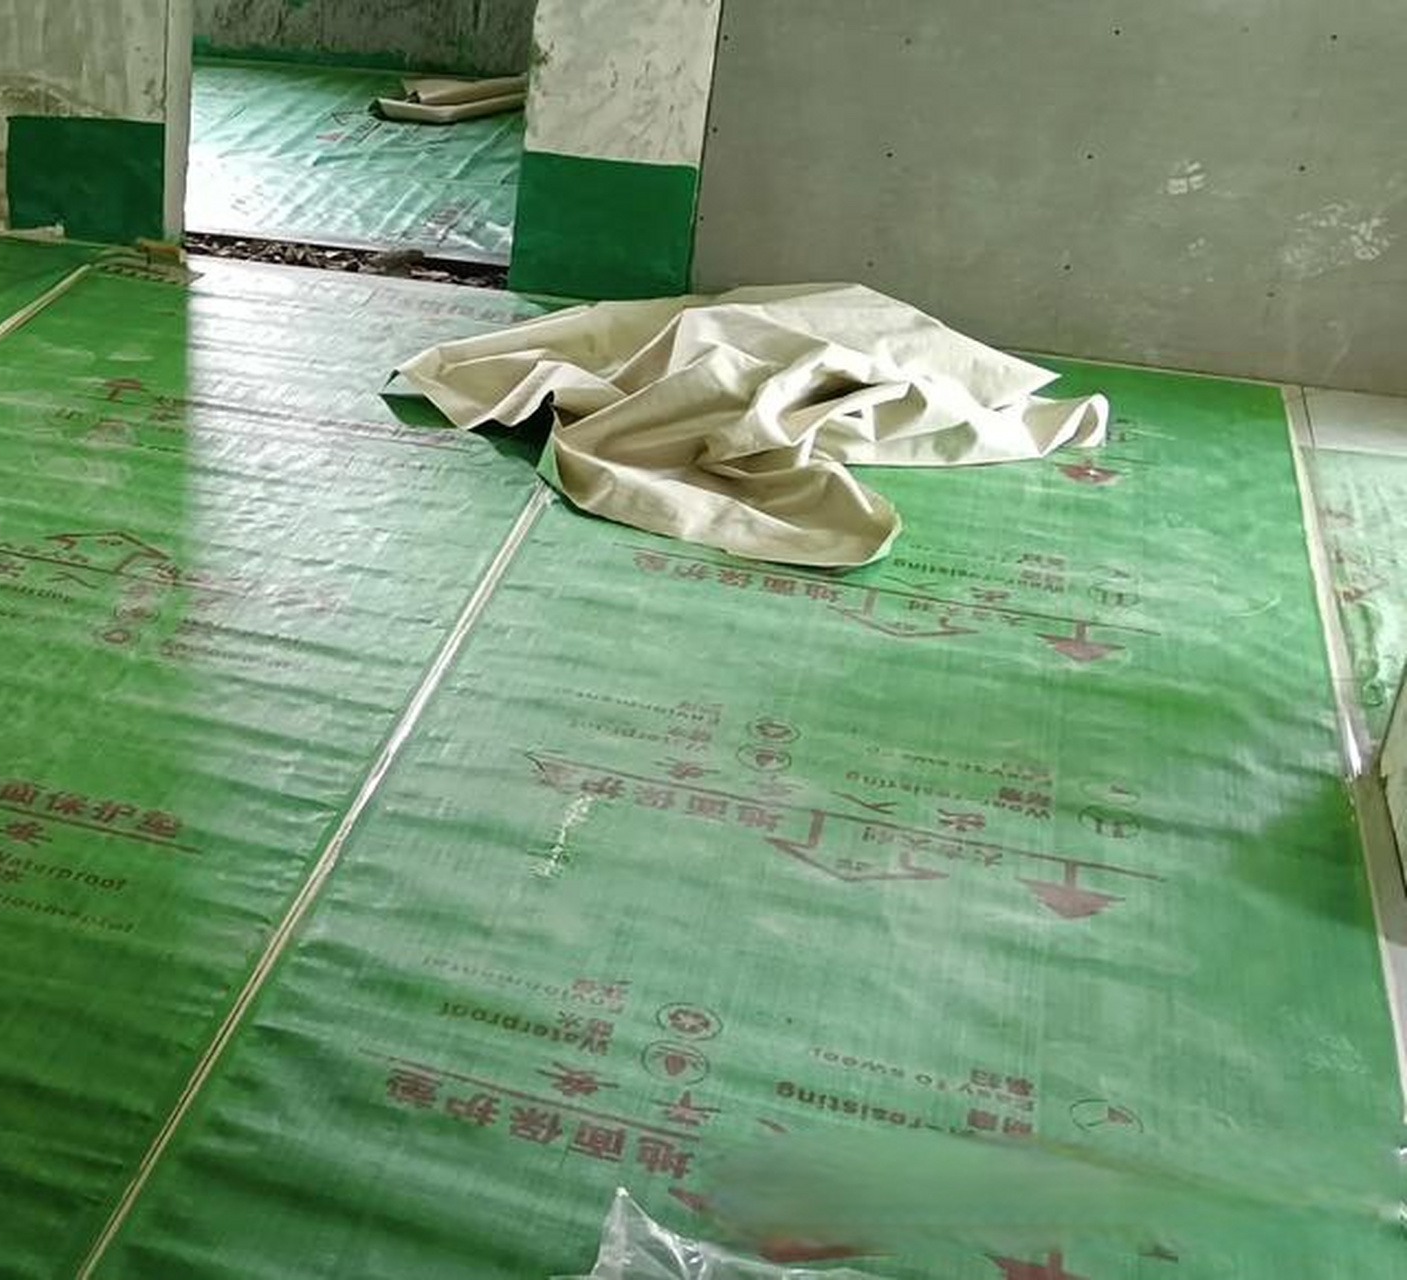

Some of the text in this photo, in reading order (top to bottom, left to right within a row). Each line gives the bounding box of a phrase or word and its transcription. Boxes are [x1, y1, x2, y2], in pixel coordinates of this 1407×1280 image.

[436, 1000, 612, 1056] Waterproof
[385, 1066, 697, 1180] 地面保护垫
